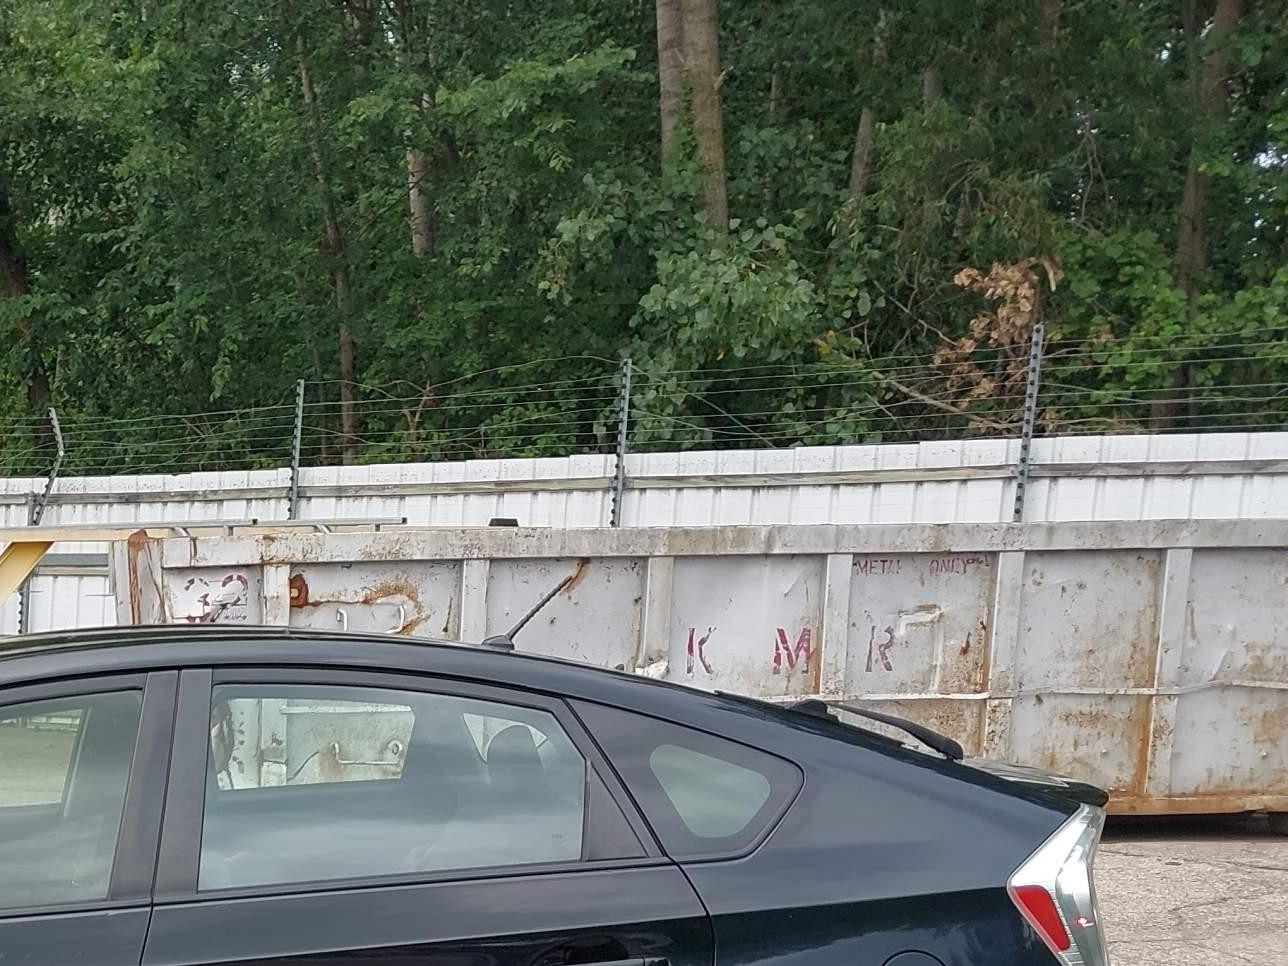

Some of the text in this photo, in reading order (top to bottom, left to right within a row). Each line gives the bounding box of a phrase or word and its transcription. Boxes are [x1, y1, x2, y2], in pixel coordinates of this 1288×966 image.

[686, 625, 896, 675] K M R
